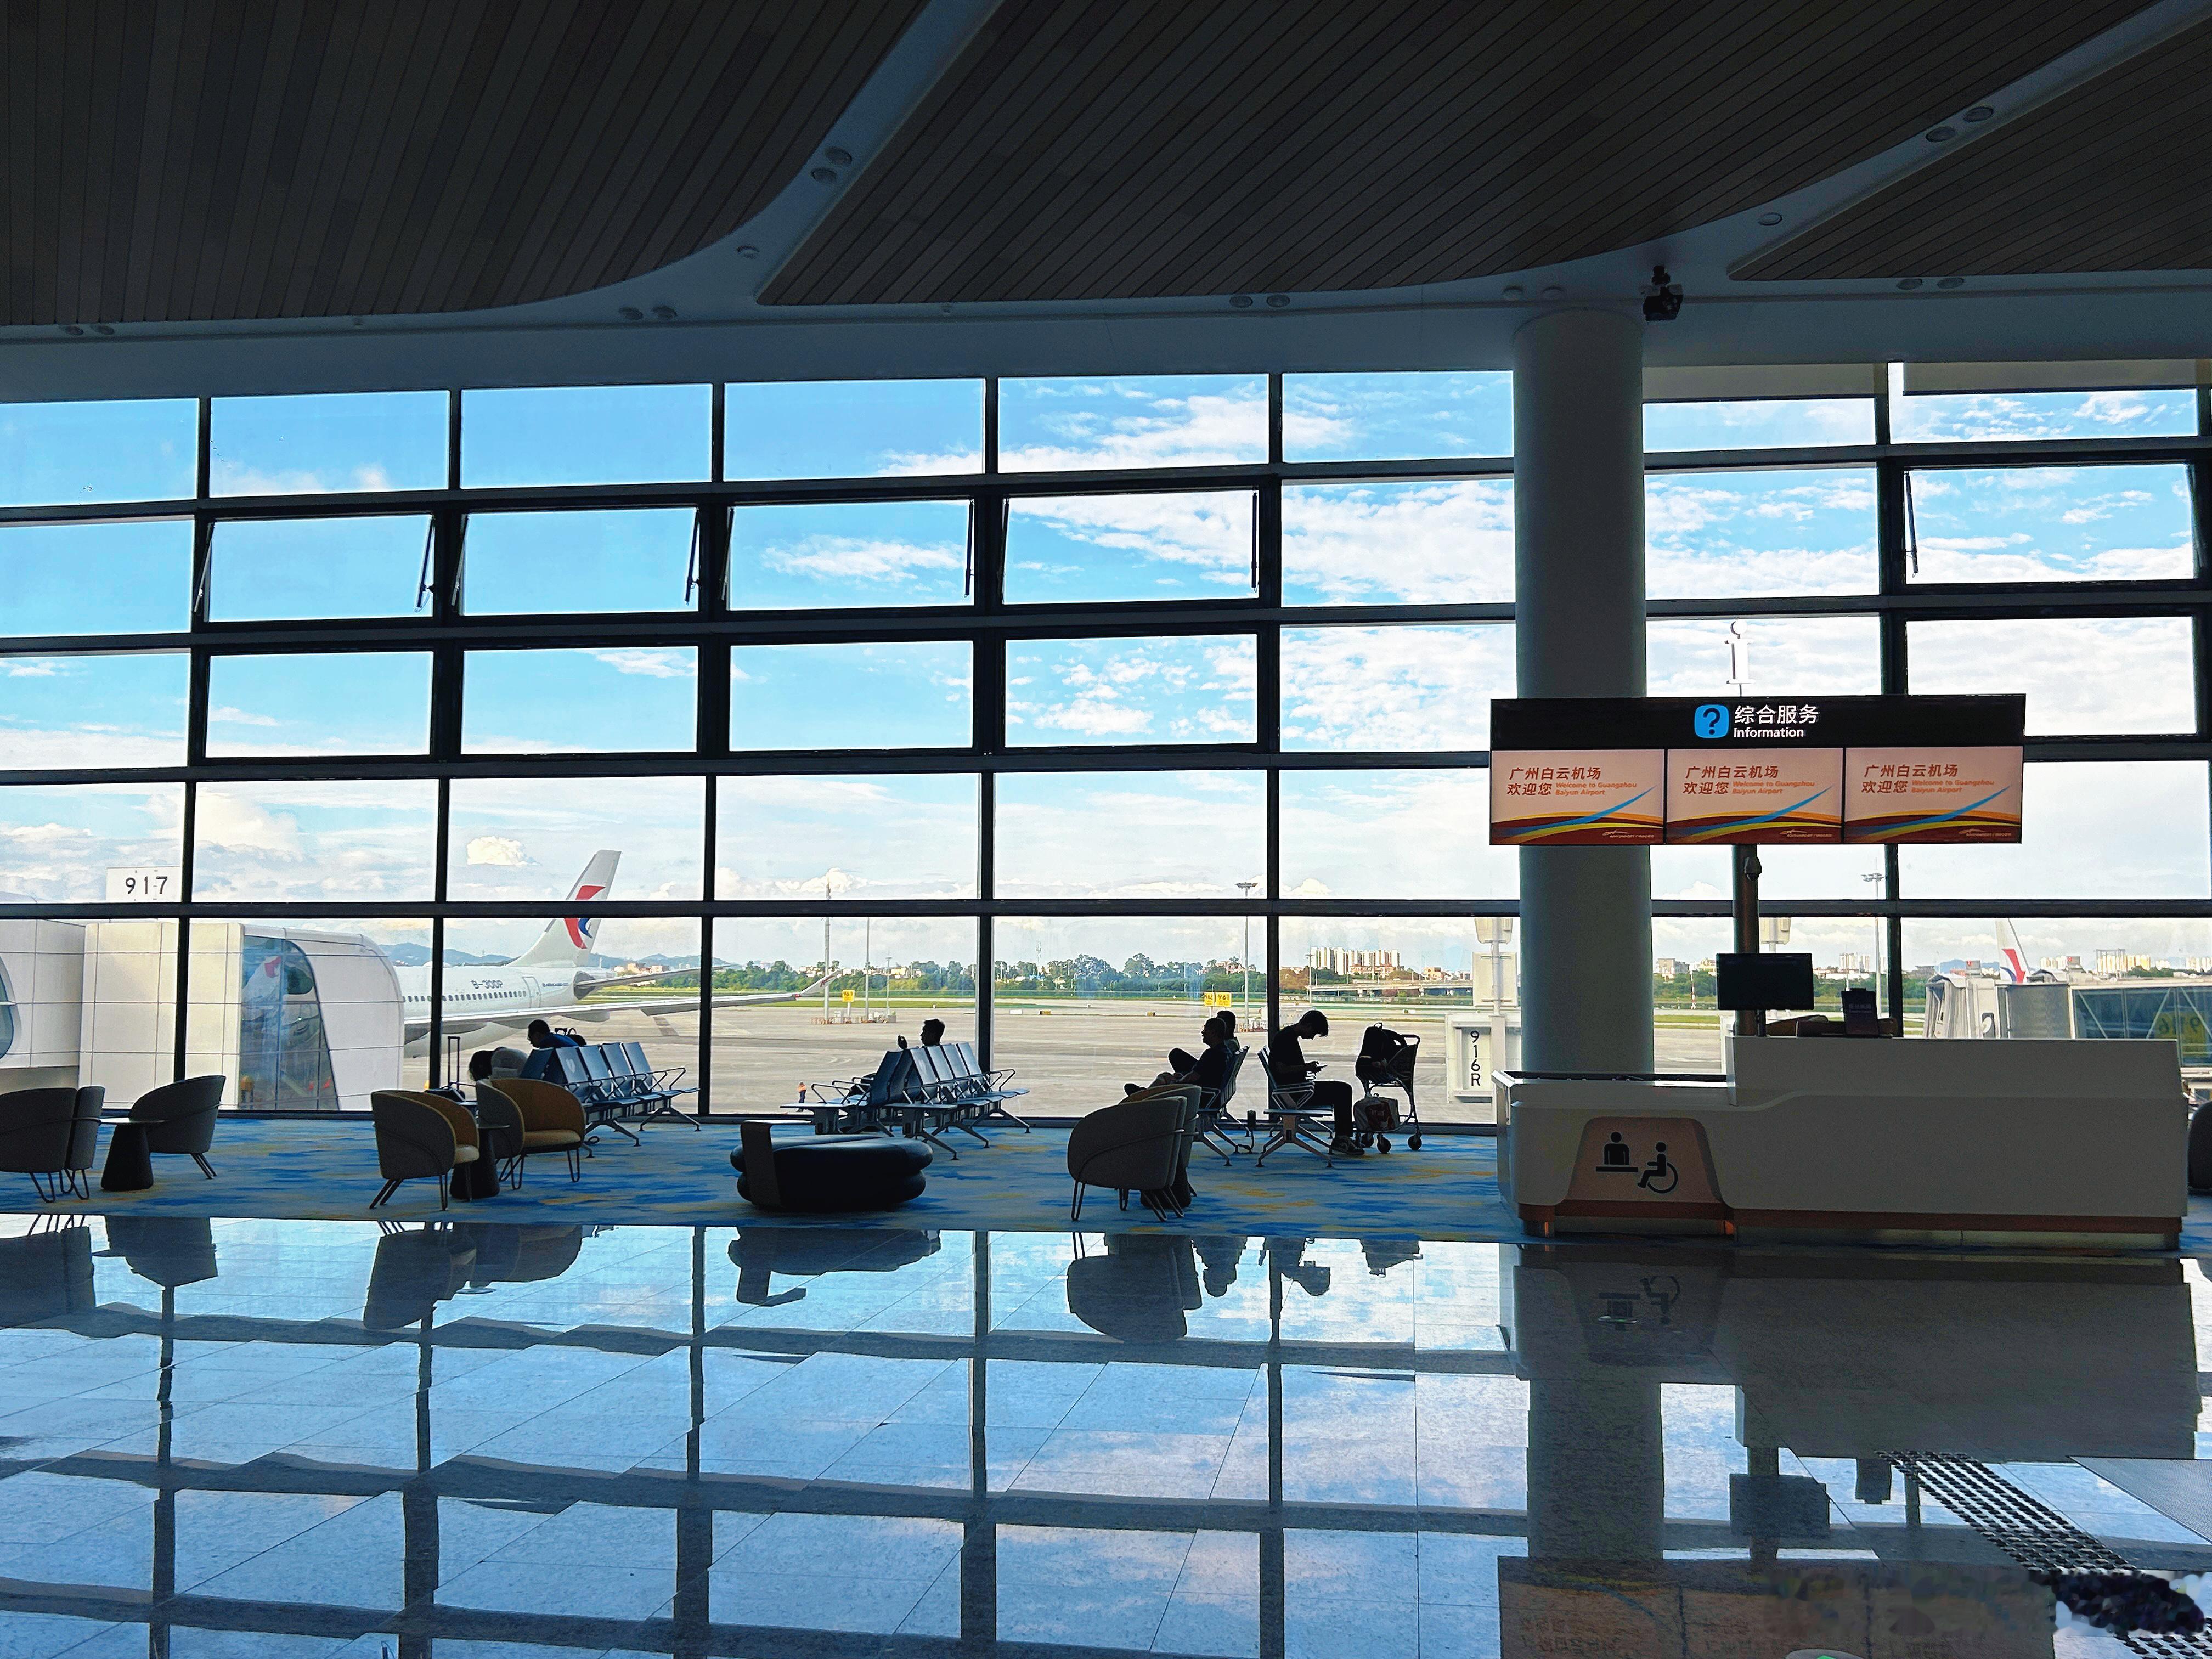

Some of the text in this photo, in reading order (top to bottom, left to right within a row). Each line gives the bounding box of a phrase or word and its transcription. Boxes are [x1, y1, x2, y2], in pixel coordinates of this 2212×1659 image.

[1734, 704, 1819, 724] 综合服务
[1734, 726, 1804, 738] Information
[1509, 766, 1601, 780] 广州白云机场
[1685, 765, 1779, 779] 广州白云机场
[1864, 764, 1959, 777] 广州白云机场
[1507, 783, 1553, 795] 欢迎您
[1683, 781, 1730, 795] 欢迎您
[1861, 780, 1909, 794] 欢迎您
[125, 876, 168, 895] 917
[1470, 1030, 1481, 1086] 916R
